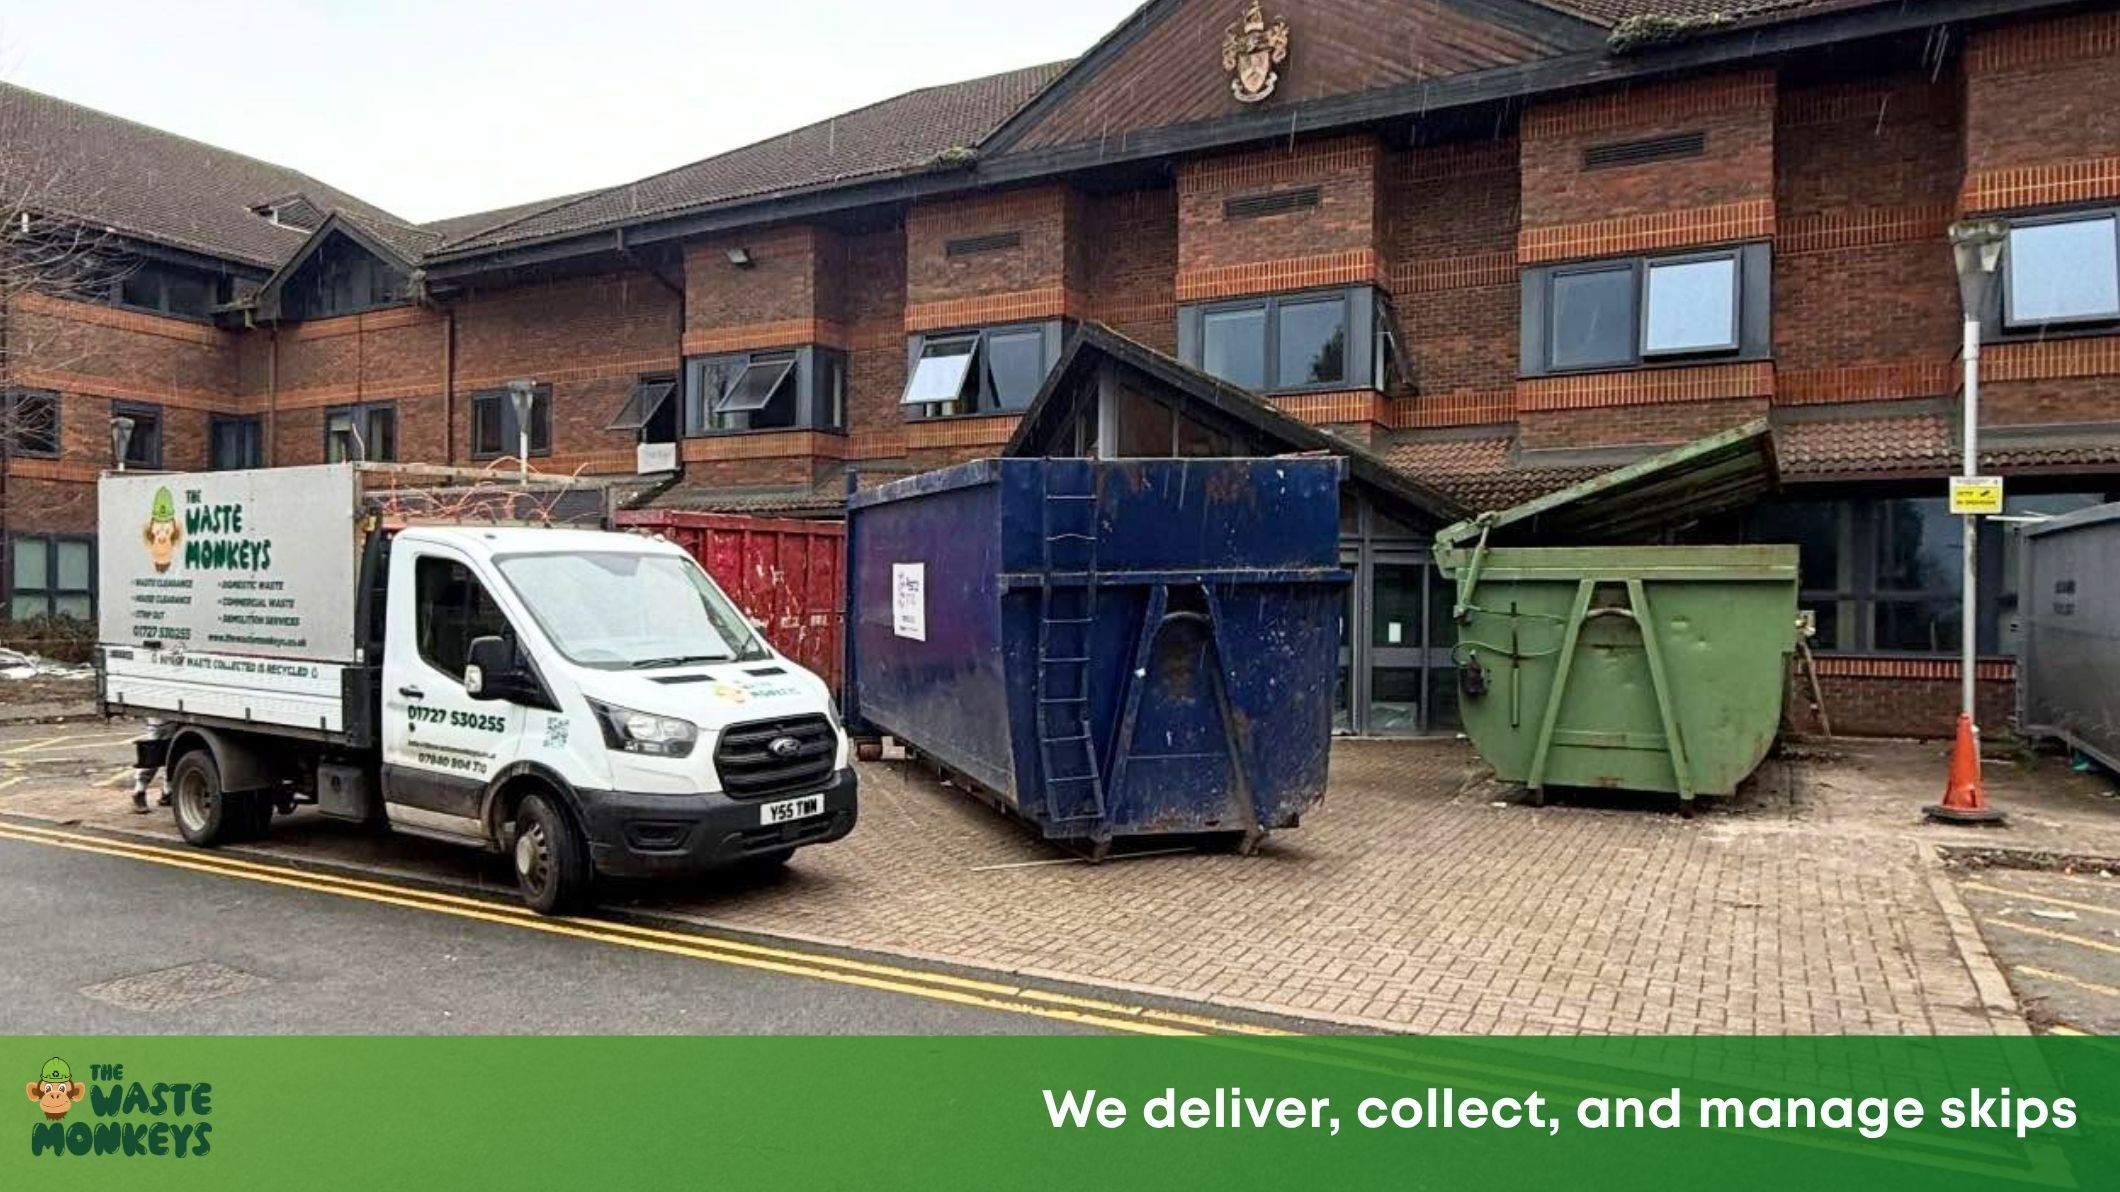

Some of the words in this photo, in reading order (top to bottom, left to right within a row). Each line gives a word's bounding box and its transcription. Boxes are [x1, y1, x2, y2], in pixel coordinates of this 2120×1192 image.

[185, 489, 201, 504] THE
[185, 504, 242, 535] WASTE
[185, 539, 271, 572] MONKEYS
[133, 625, 157, 638] 01727
[213, 659, 256, 673] COLLECTED
[266, 663, 309, 677] RECYCLED
[408, 705, 447, 723] 01727
[450, 710, 506, 733] 530255
[770, 803, 793, 821] Y55
